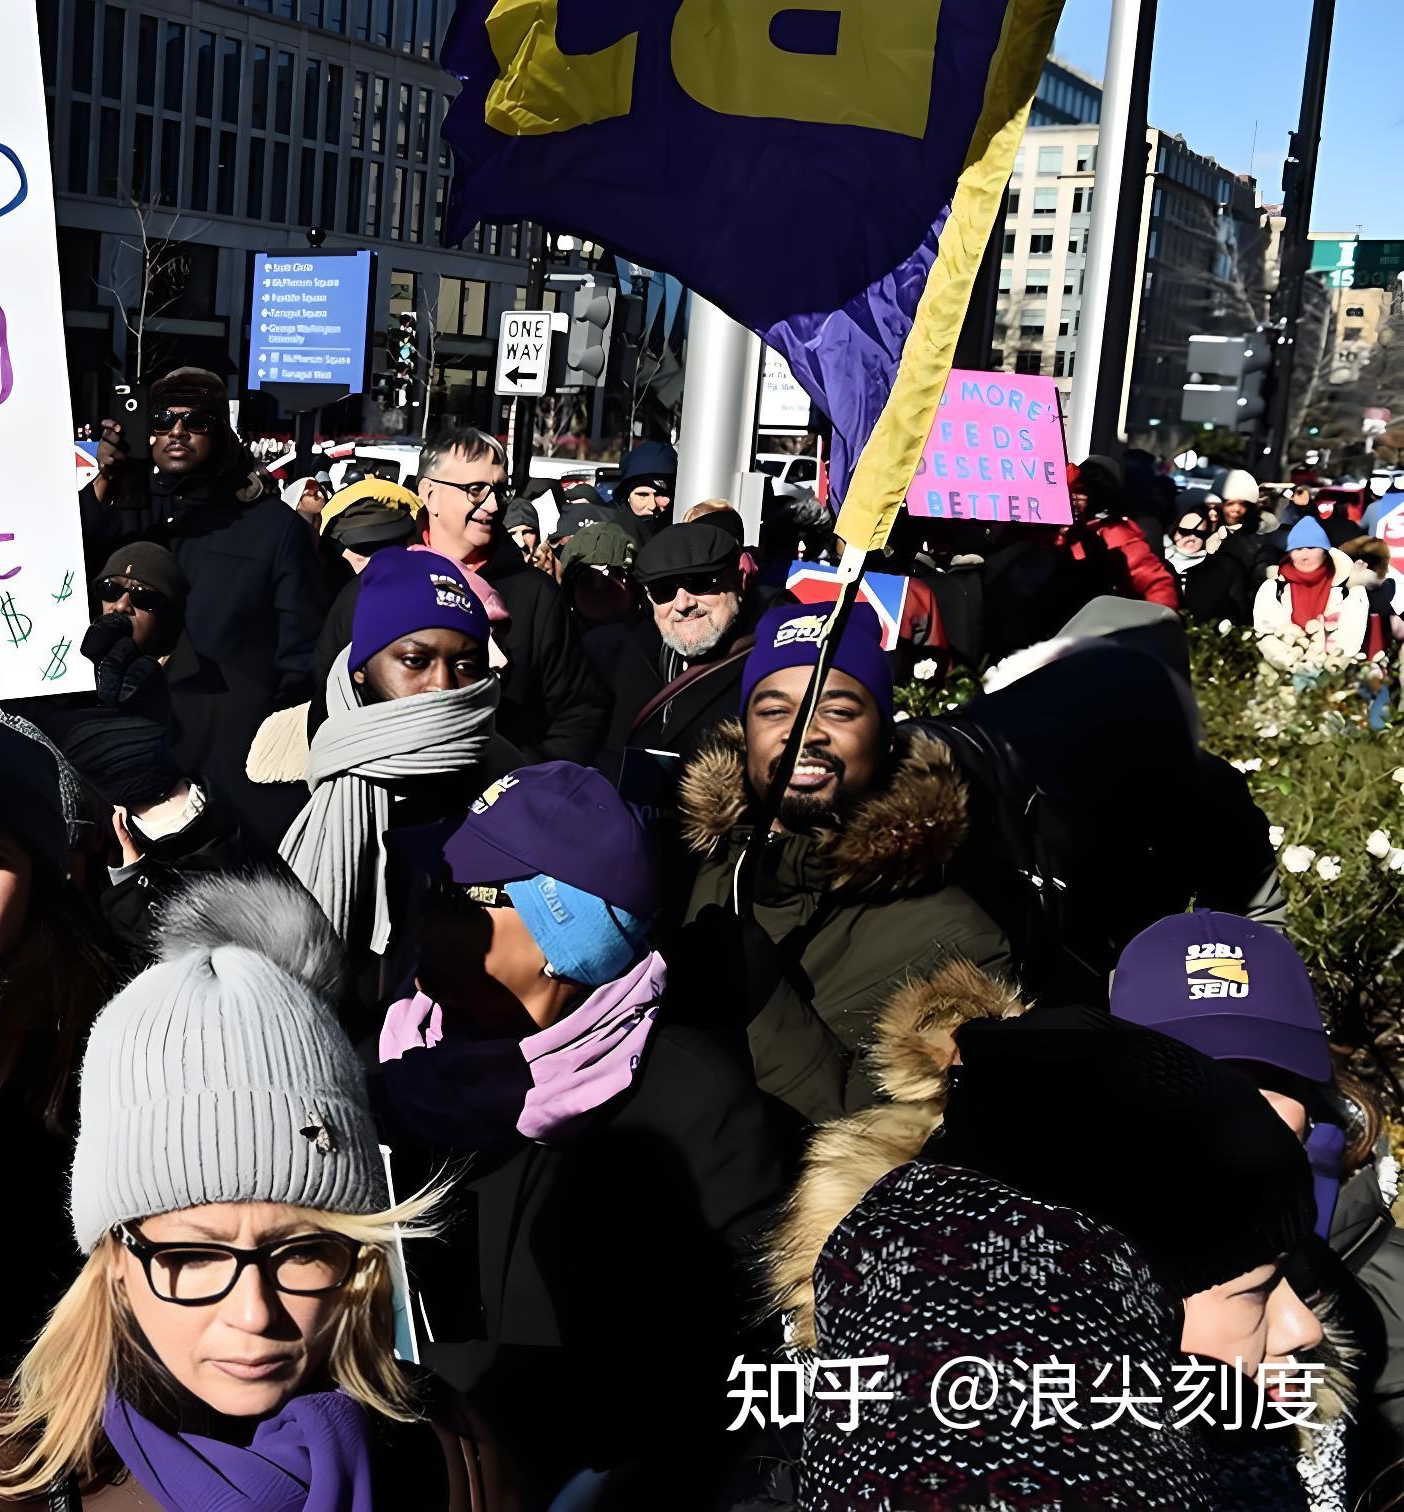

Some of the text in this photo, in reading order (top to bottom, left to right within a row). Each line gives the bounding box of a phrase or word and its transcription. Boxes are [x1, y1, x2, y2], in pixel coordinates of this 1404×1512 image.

[509, 320, 544, 338] ONE
[507, 343, 543, 360] WAY
[940, 421, 1033, 451] FEDS
[927, 490, 1042, 521] BETTER
[1188, 980, 1249, 1000] SEIU
